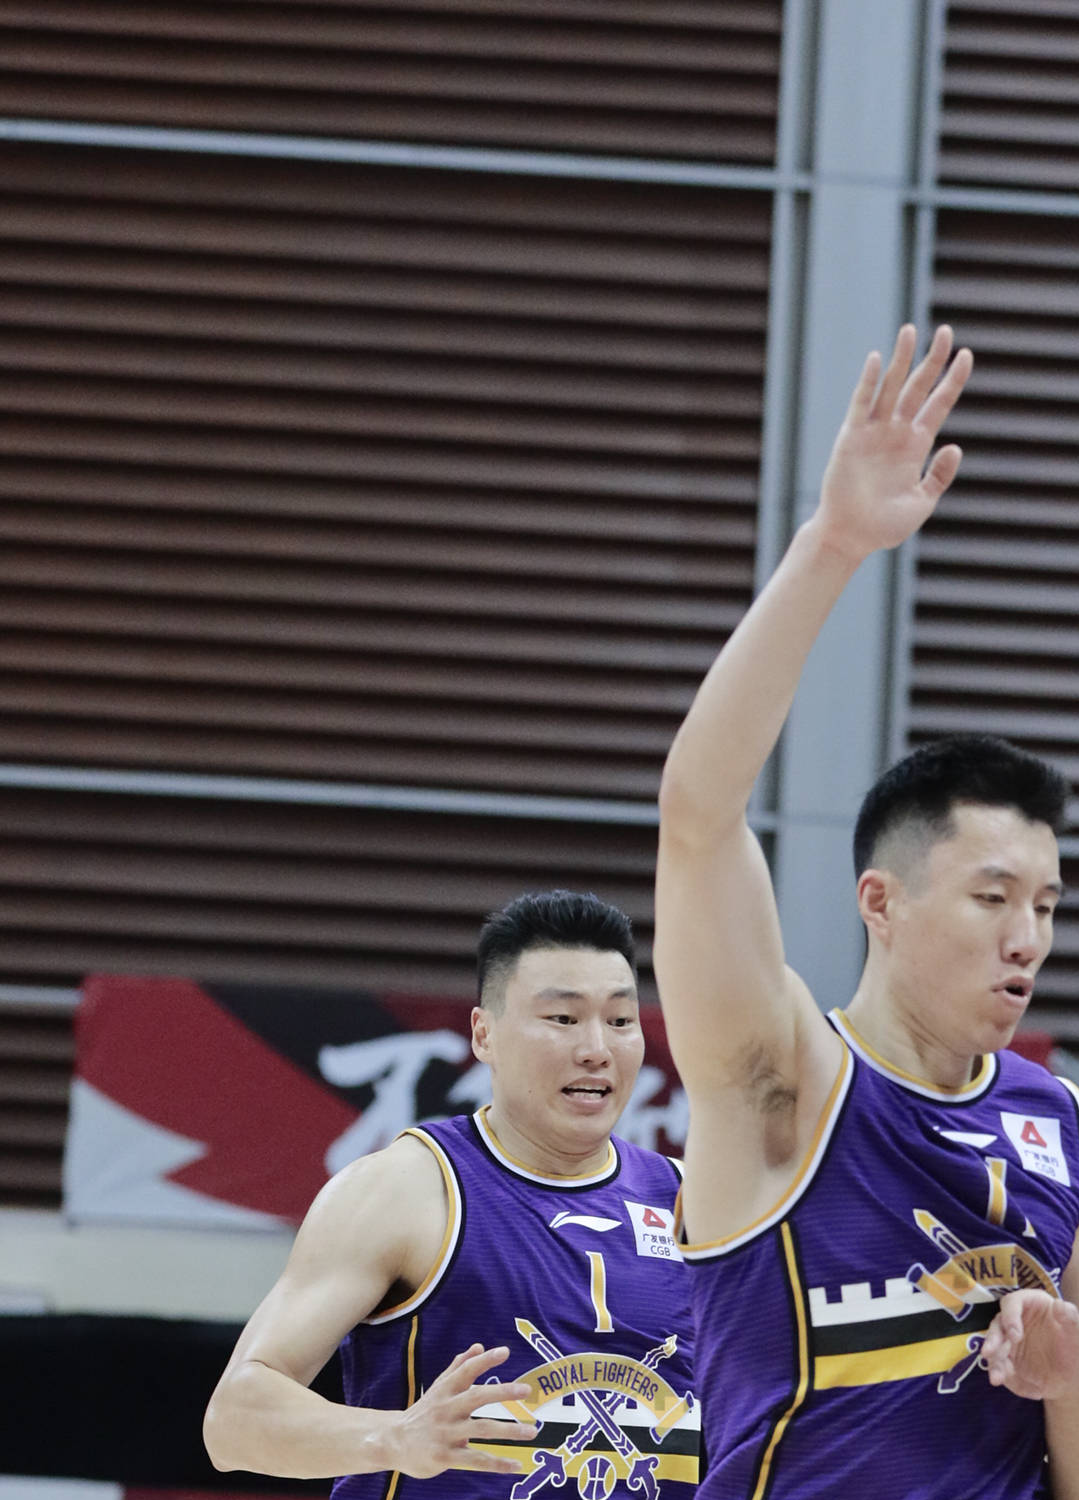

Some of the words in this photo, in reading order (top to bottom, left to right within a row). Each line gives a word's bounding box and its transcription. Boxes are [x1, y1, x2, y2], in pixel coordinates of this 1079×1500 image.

[650, 1245, 672, 1257] CGB
[584, 1250, 615, 1333] 1
[537, 1362, 589, 1396] ROYAL
[593, 1360, 660, 1401] FIGHTERS
